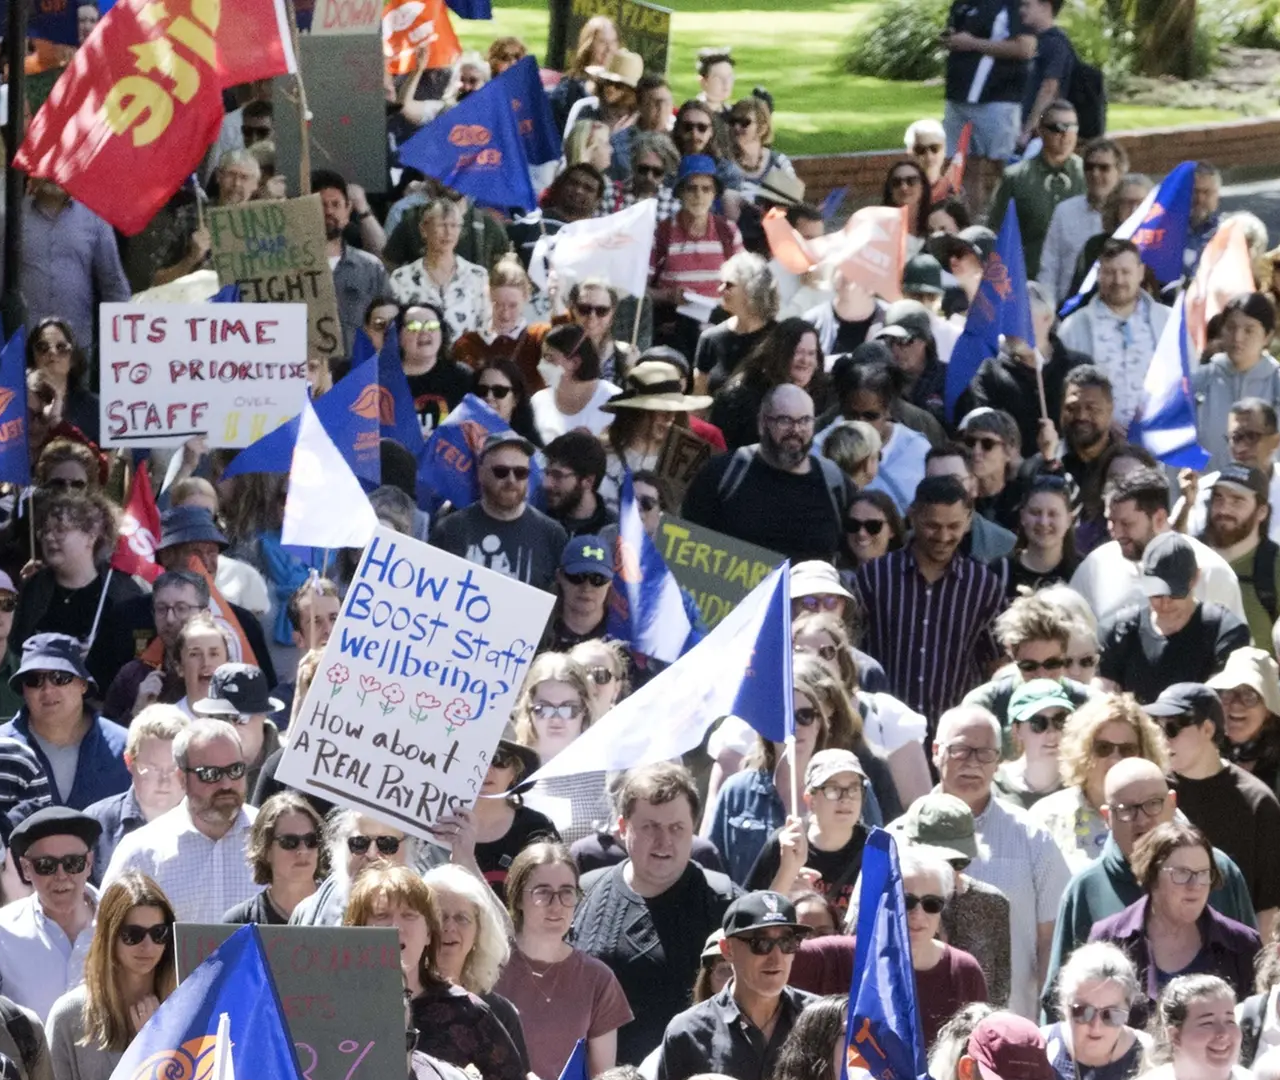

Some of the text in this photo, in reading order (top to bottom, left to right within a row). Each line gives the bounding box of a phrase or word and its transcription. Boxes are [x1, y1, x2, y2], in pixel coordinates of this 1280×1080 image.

[234, 271, 322, 303] FIGHT
[111, 313, 279, 345] ITS TIME
[111, 361, 152, 385] TO
[105, 399, 209, 436] STAFF
[454, 569, 491, 623] to
[293, 731, 311, 754] A
[312, 737, 371, 790] REAL
[372, 729, 462, 774] about
